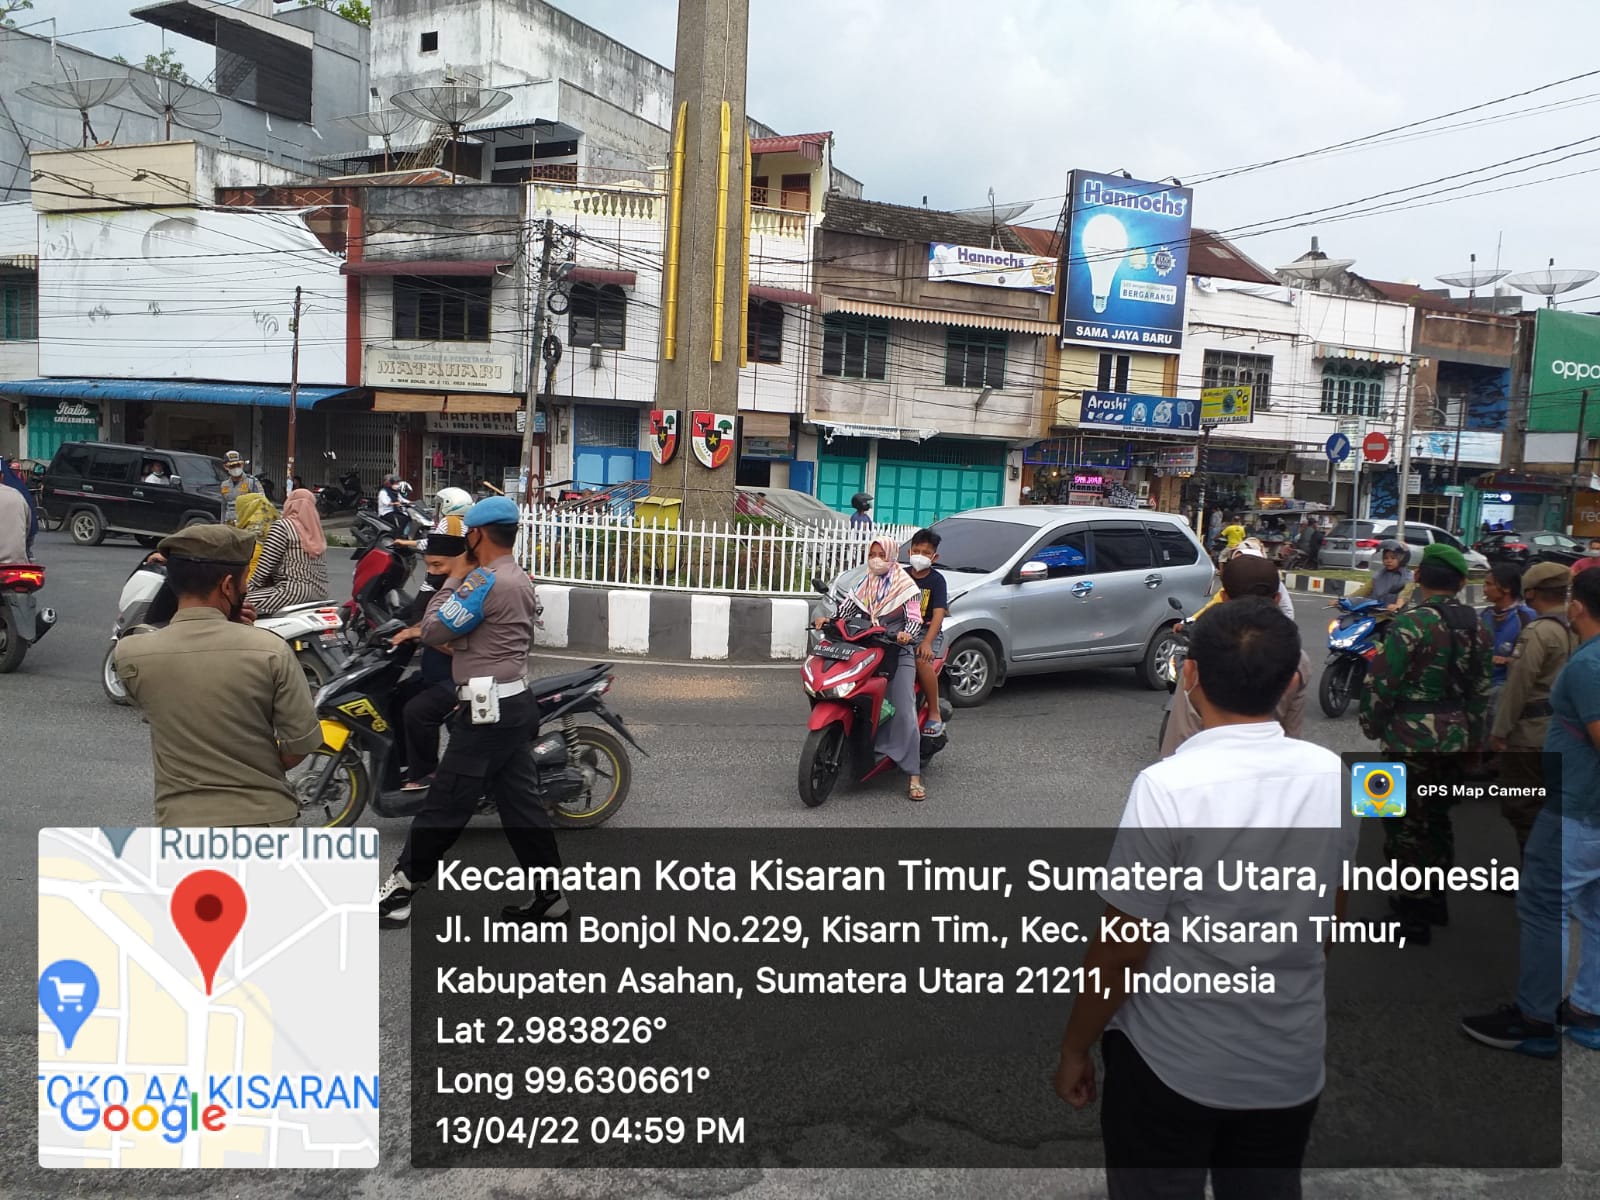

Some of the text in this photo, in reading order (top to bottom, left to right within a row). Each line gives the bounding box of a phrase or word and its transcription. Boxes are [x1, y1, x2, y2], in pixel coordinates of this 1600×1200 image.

[1085, 180, 1185, 216] Hannochs
[957, 247, 1025, 268] Hannochs
[1122, 289, 1175, 303] BERGARANSI
[1076, 325, 1173, 344] SAMA JAYA BARU
[377, 359, 503, 379] MATAHARI
[1552, 360, 1600, 381] oppo
[56, 401, 90, 416] Italia
[1087, 394, 1127, 411] Arashi
[440, 412, 513, 424] MATAHAR
